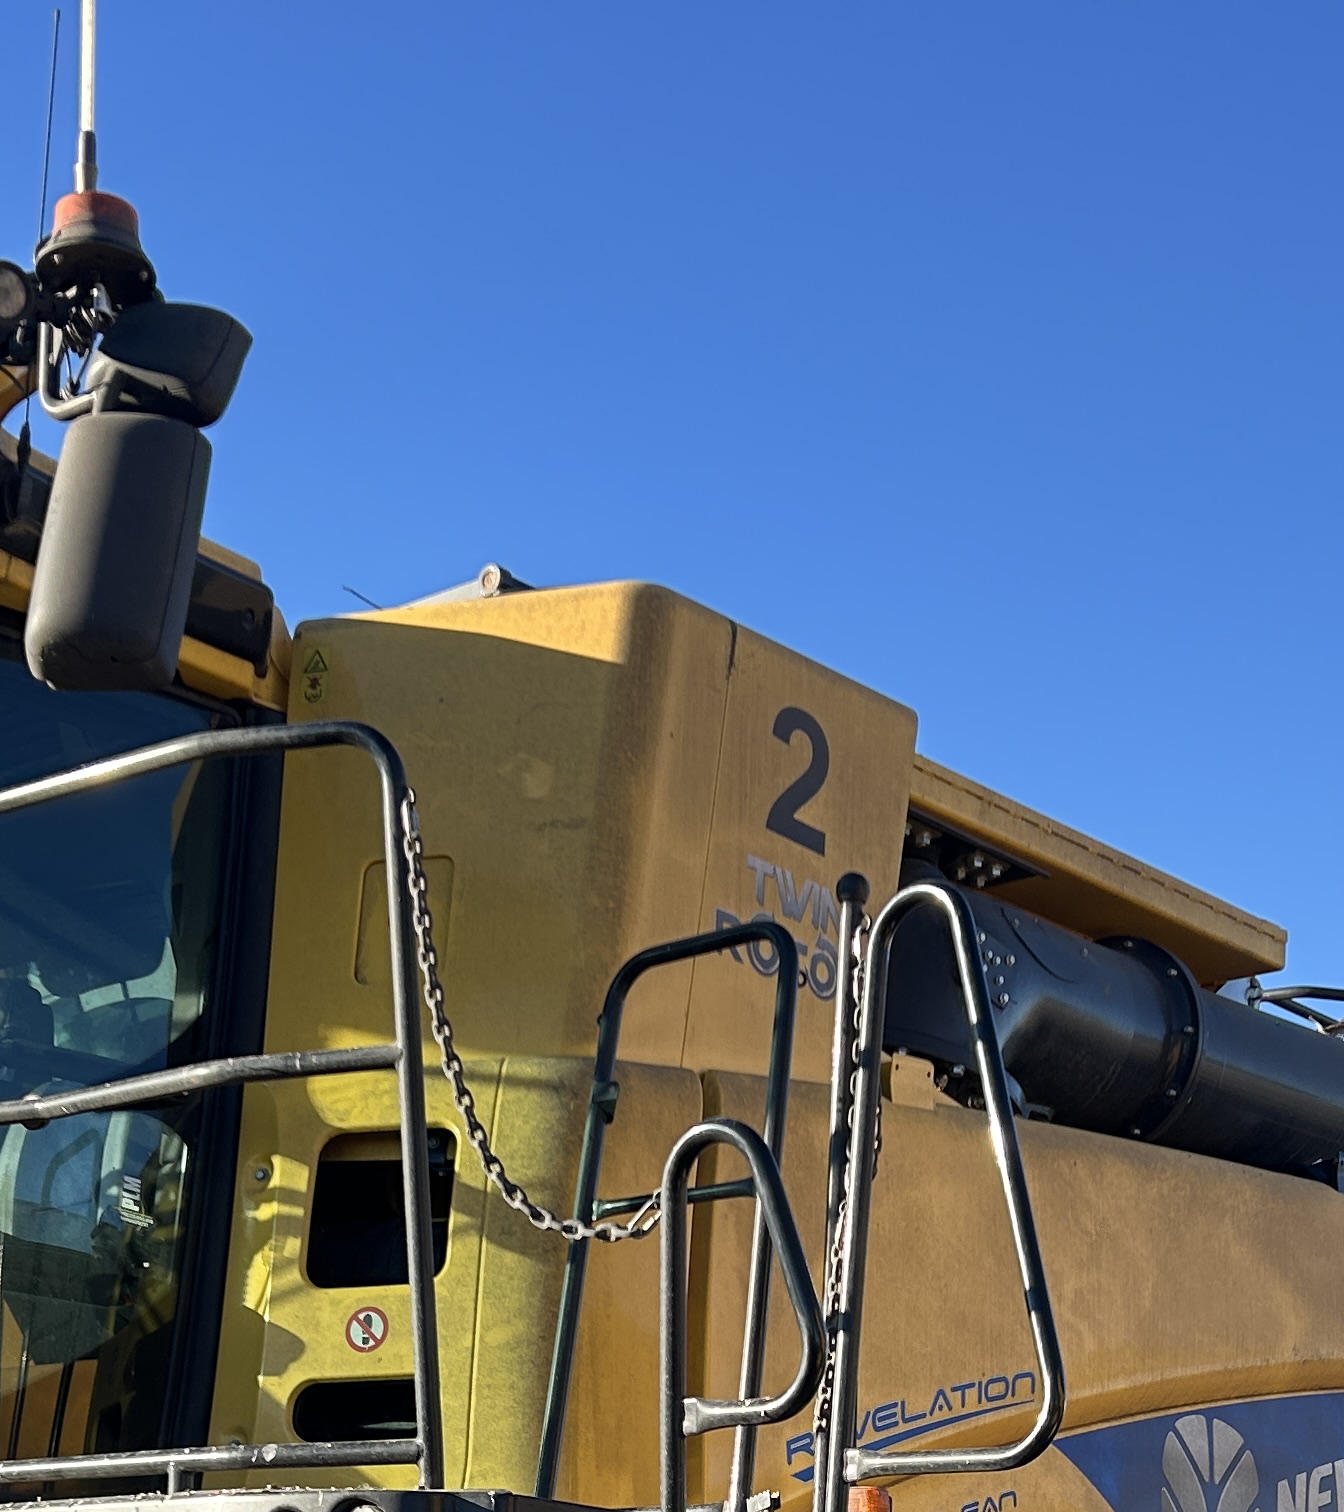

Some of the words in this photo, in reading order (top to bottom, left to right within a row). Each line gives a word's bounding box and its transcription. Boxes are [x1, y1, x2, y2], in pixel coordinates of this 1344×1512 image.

[766, 706, 830, 857] 2
[747, 855, 839, 936] TWIN
[786, 1371, 1036, 1465] RVELATION
